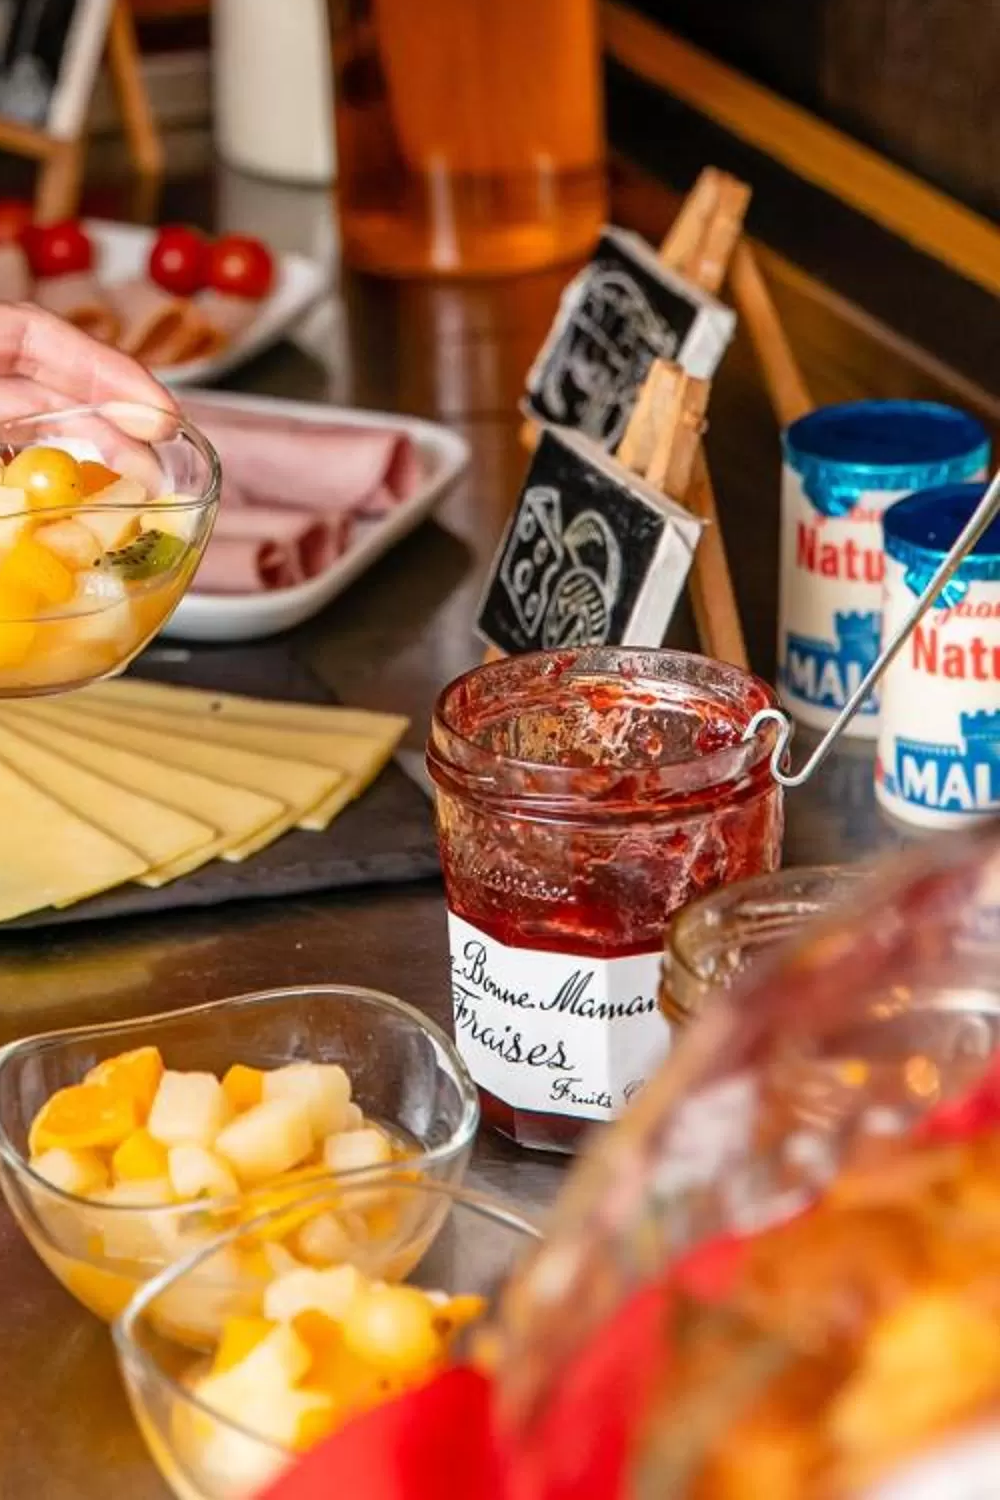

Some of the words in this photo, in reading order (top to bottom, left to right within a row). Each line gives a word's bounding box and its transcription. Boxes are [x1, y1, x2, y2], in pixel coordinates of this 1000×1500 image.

[796, 523, 885, 583] Natu
[463, 940, 535, 1009] Bonne
[452, 982, 575, 1071] Fraises
[550, 1077, 612, 1108] Fruits
